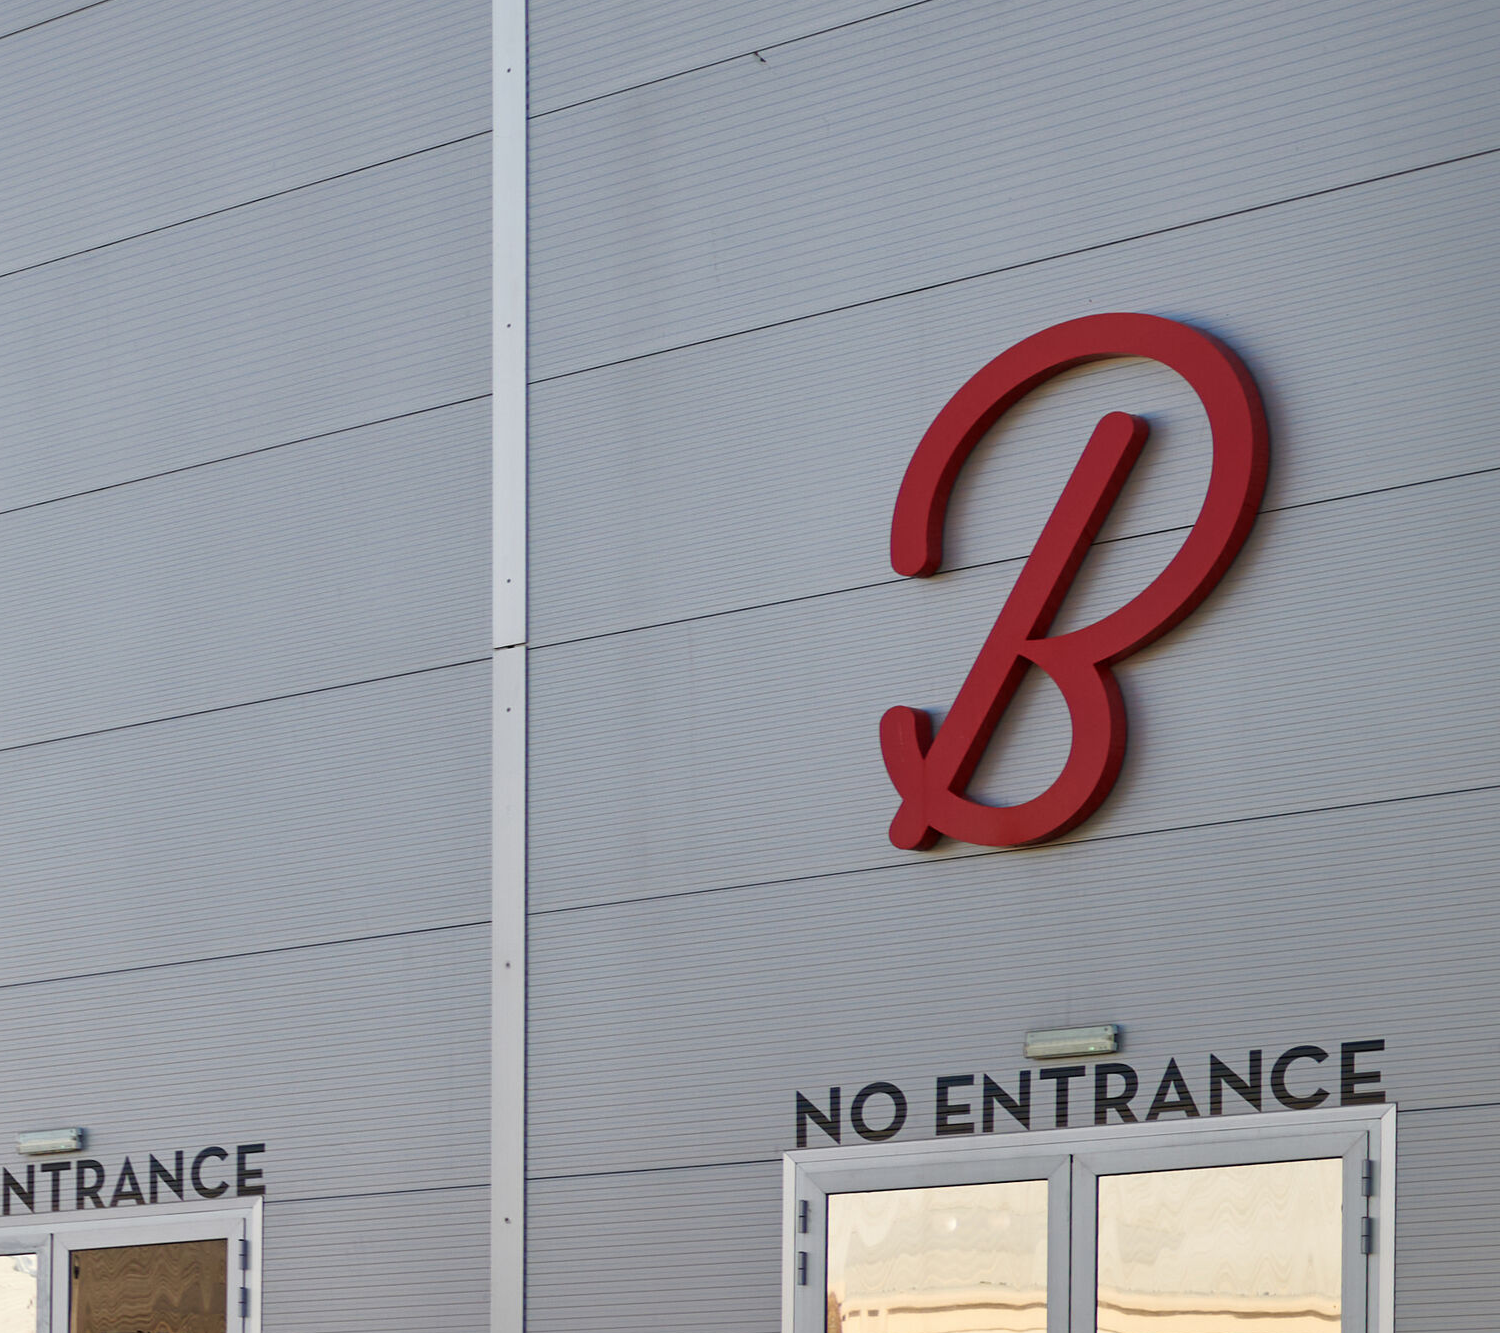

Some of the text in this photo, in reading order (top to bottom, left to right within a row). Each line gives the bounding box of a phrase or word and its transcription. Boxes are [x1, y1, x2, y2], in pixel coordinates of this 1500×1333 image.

[879, 311, 1272, 852] B
[795, 1038, 1387, 1149] NO ENTRANCE
